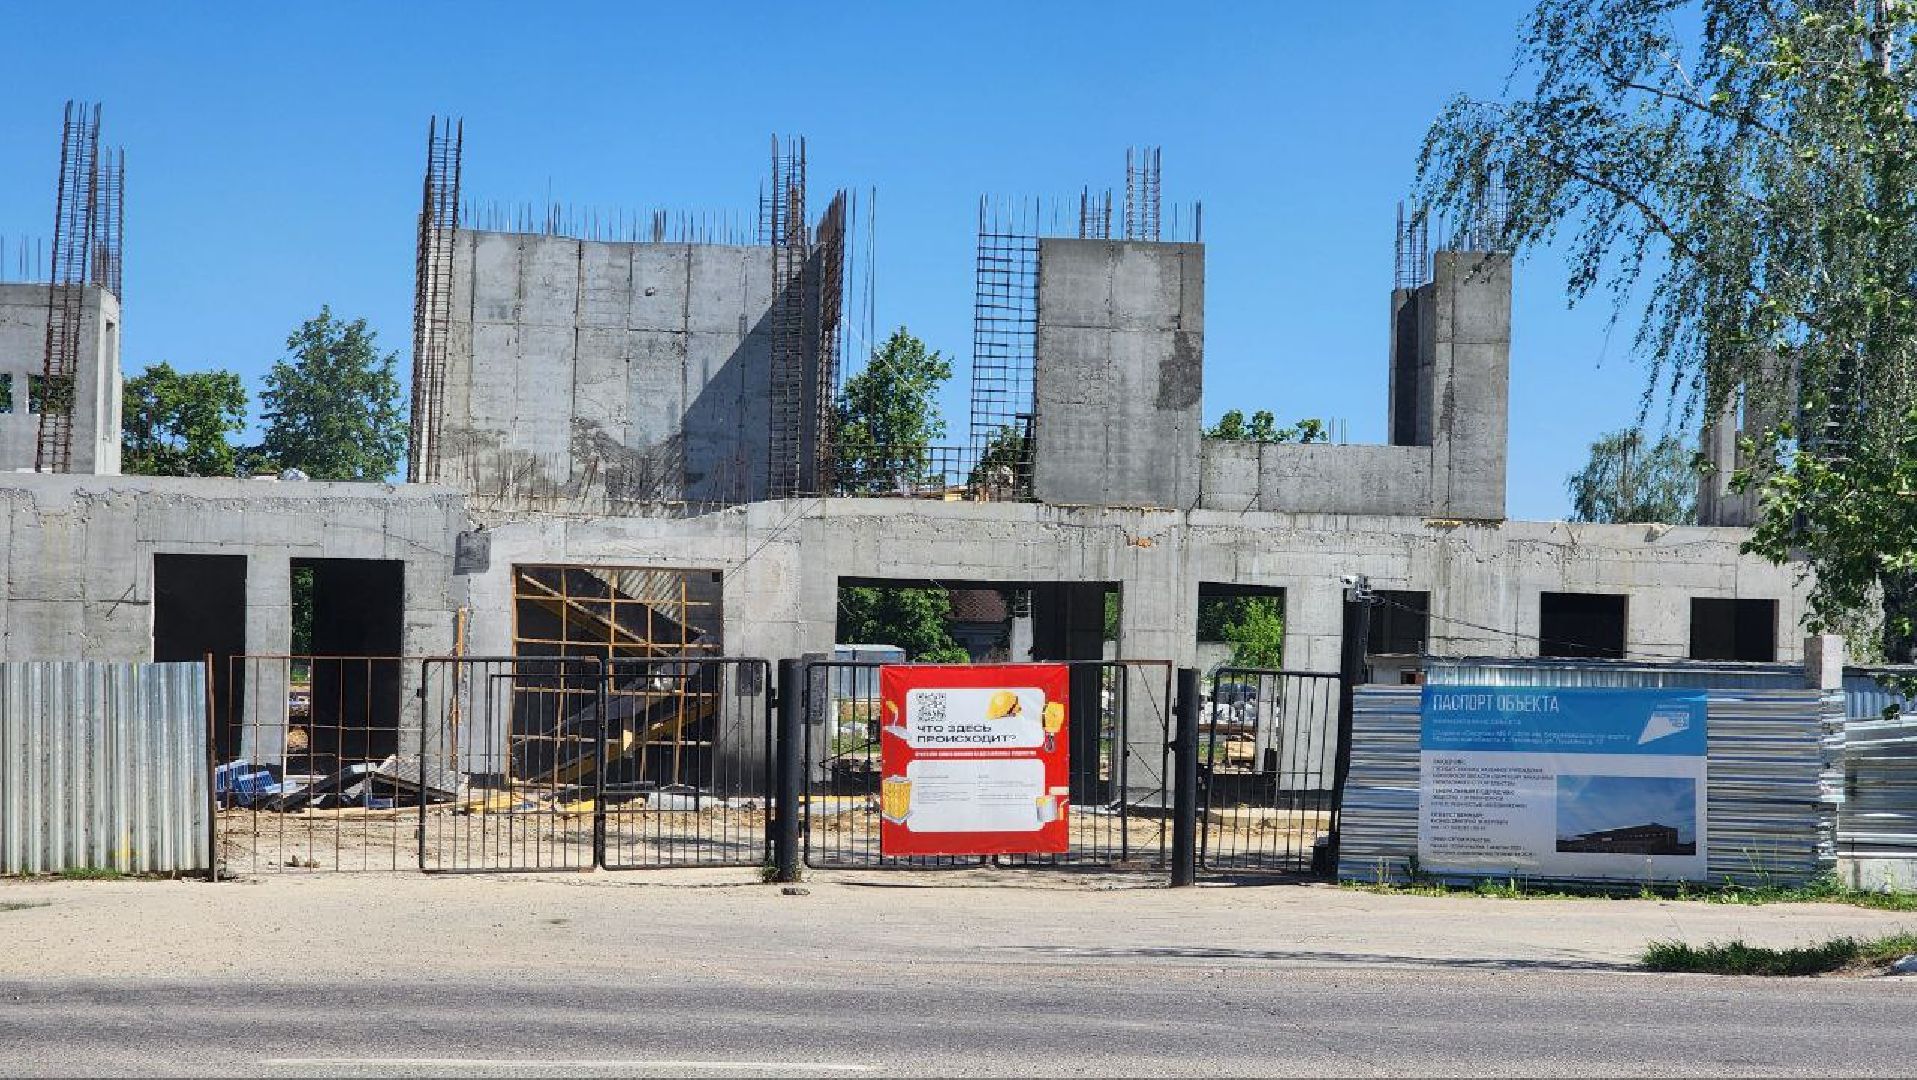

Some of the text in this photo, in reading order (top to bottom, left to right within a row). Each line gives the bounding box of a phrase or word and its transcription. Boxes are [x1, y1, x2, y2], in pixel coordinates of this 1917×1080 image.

[1433, 694, 1560, 713] ПАСПОРТ ОБЪЕКТА
[917, 725, 992, 734] ЧТО ЗДЕСЬ
[917, 734, 1017, 744] ПРОИСХОДИТ?
